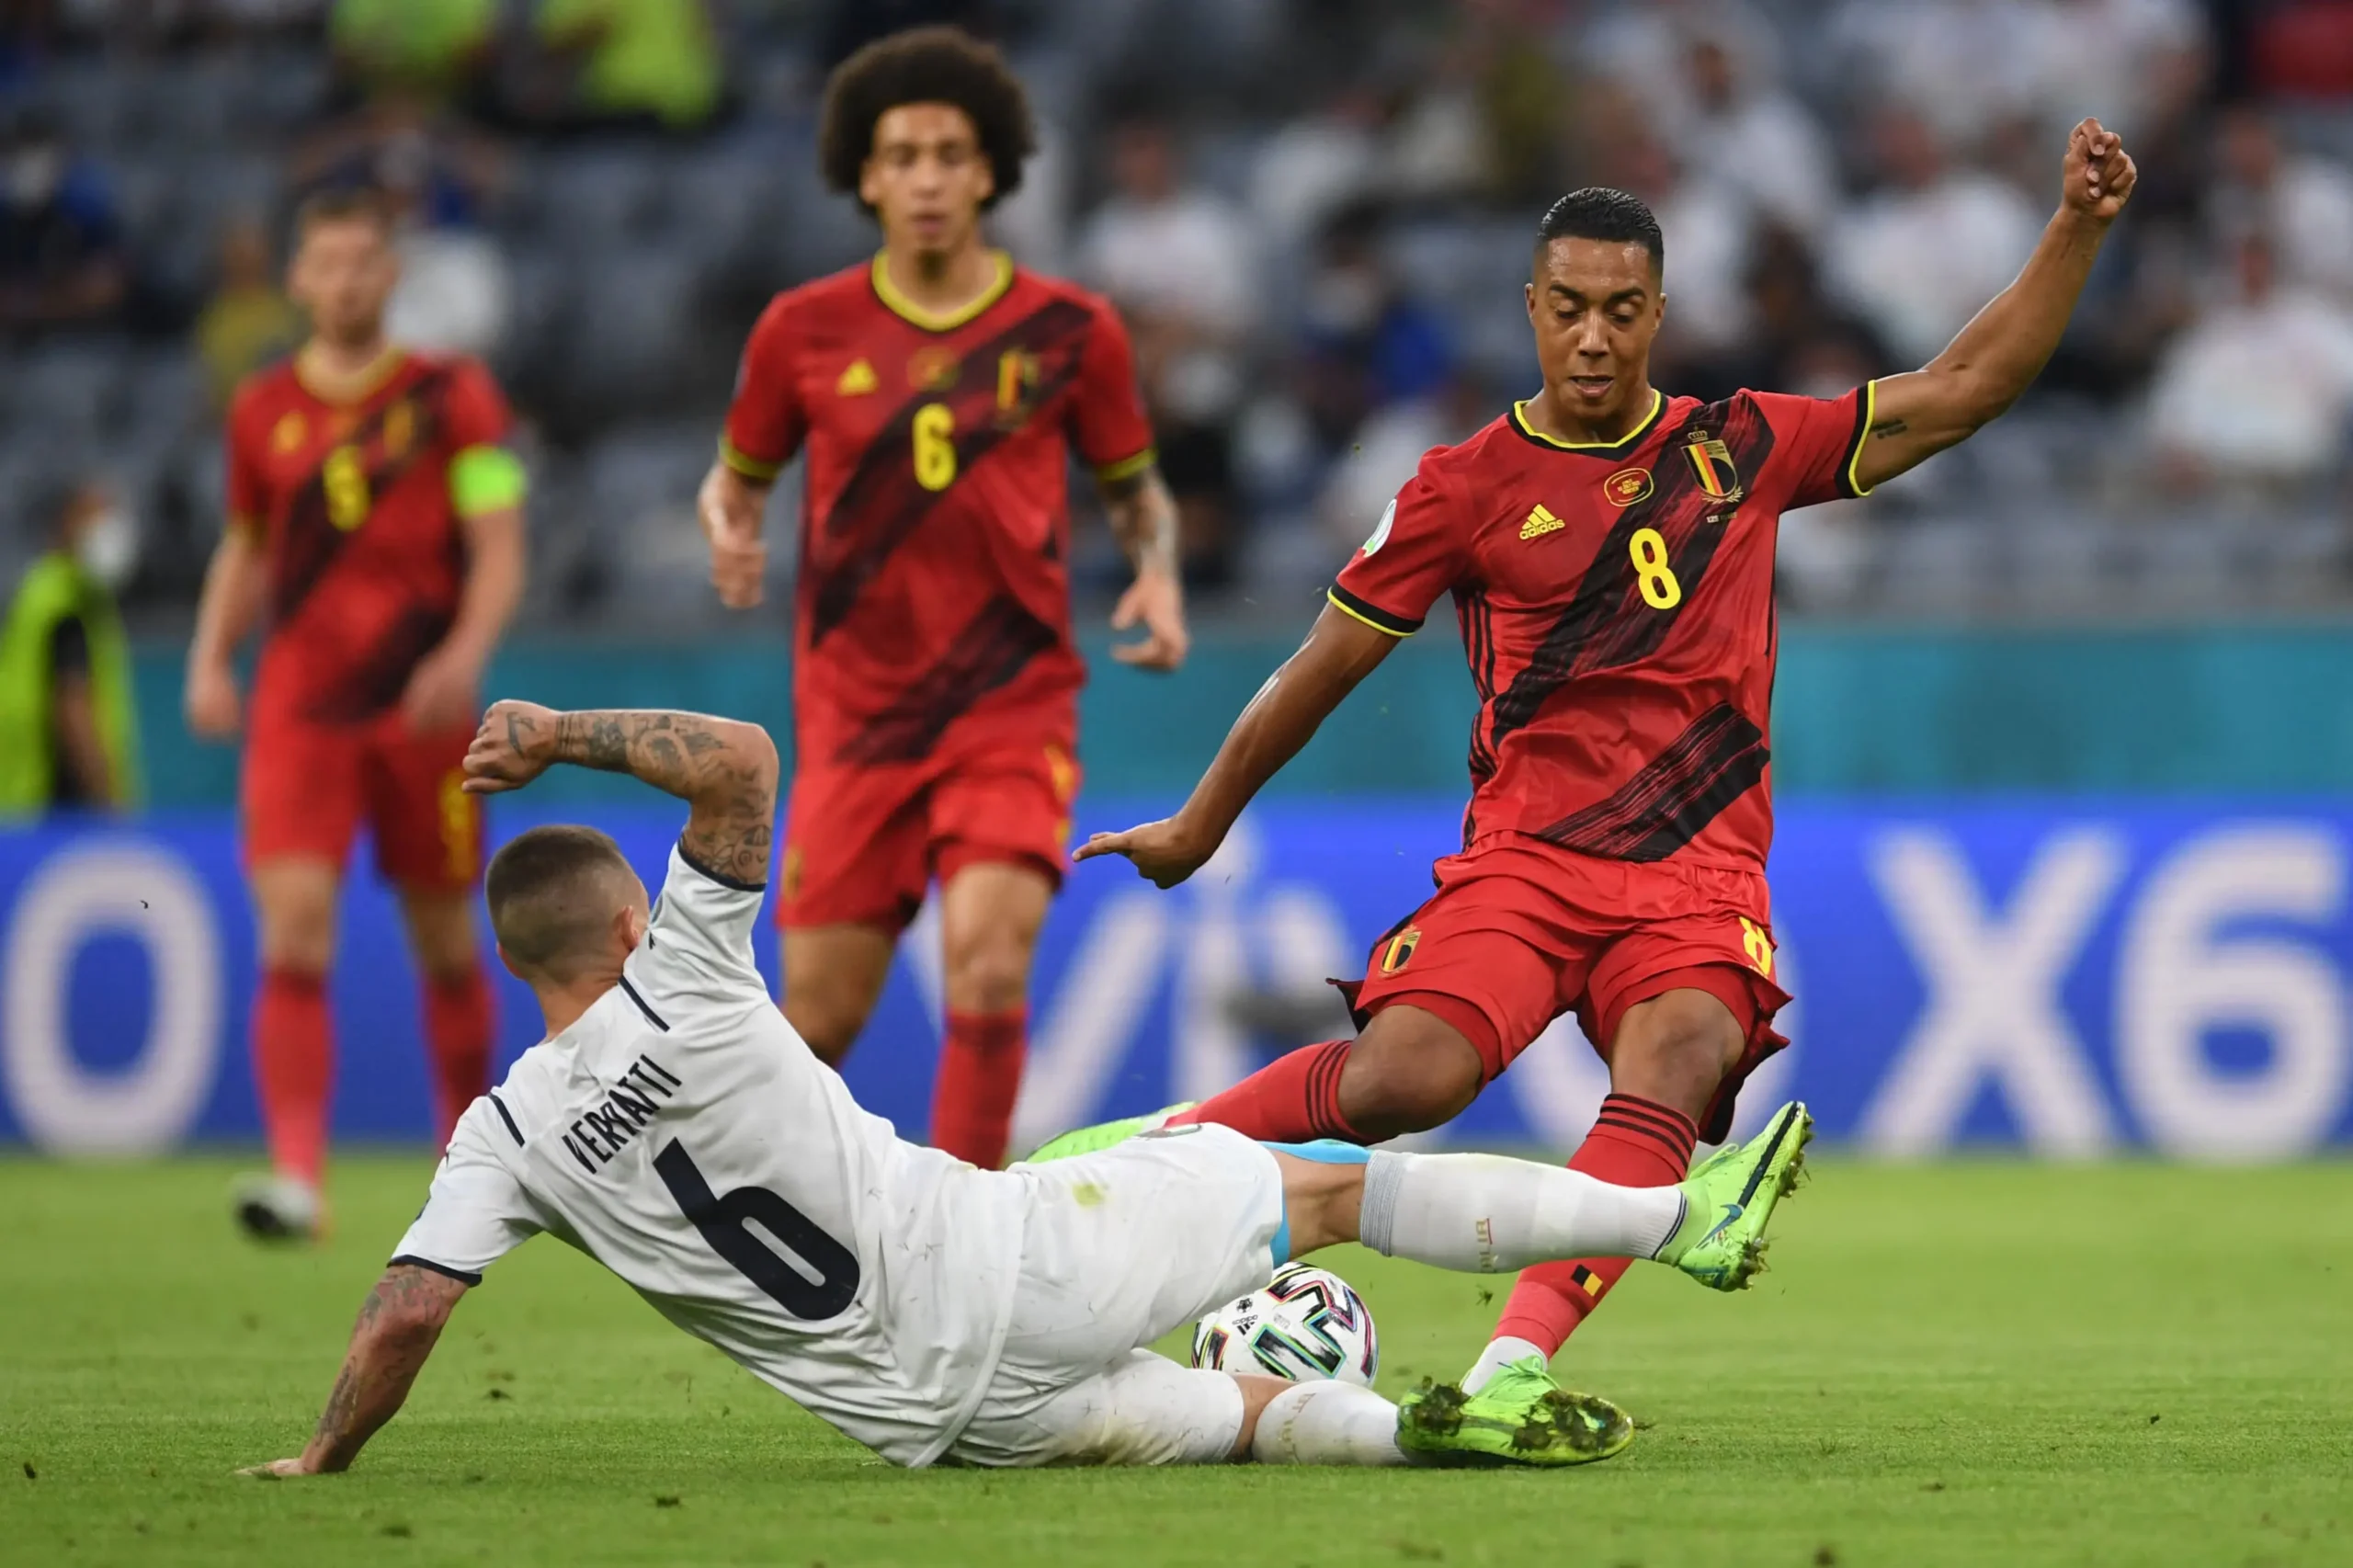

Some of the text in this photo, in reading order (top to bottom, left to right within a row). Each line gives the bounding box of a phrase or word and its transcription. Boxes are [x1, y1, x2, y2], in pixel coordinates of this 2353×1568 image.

[913, 403, 957, 492] 6
[1518, 518, 1565, 540] adidas
[1630, 528, 1681, 609] 8
[1859, 820, 2346, 1163] X6
[562, 1053, 682, 1175] VERRATTI
[653, 1136, 860, 1321] 6
